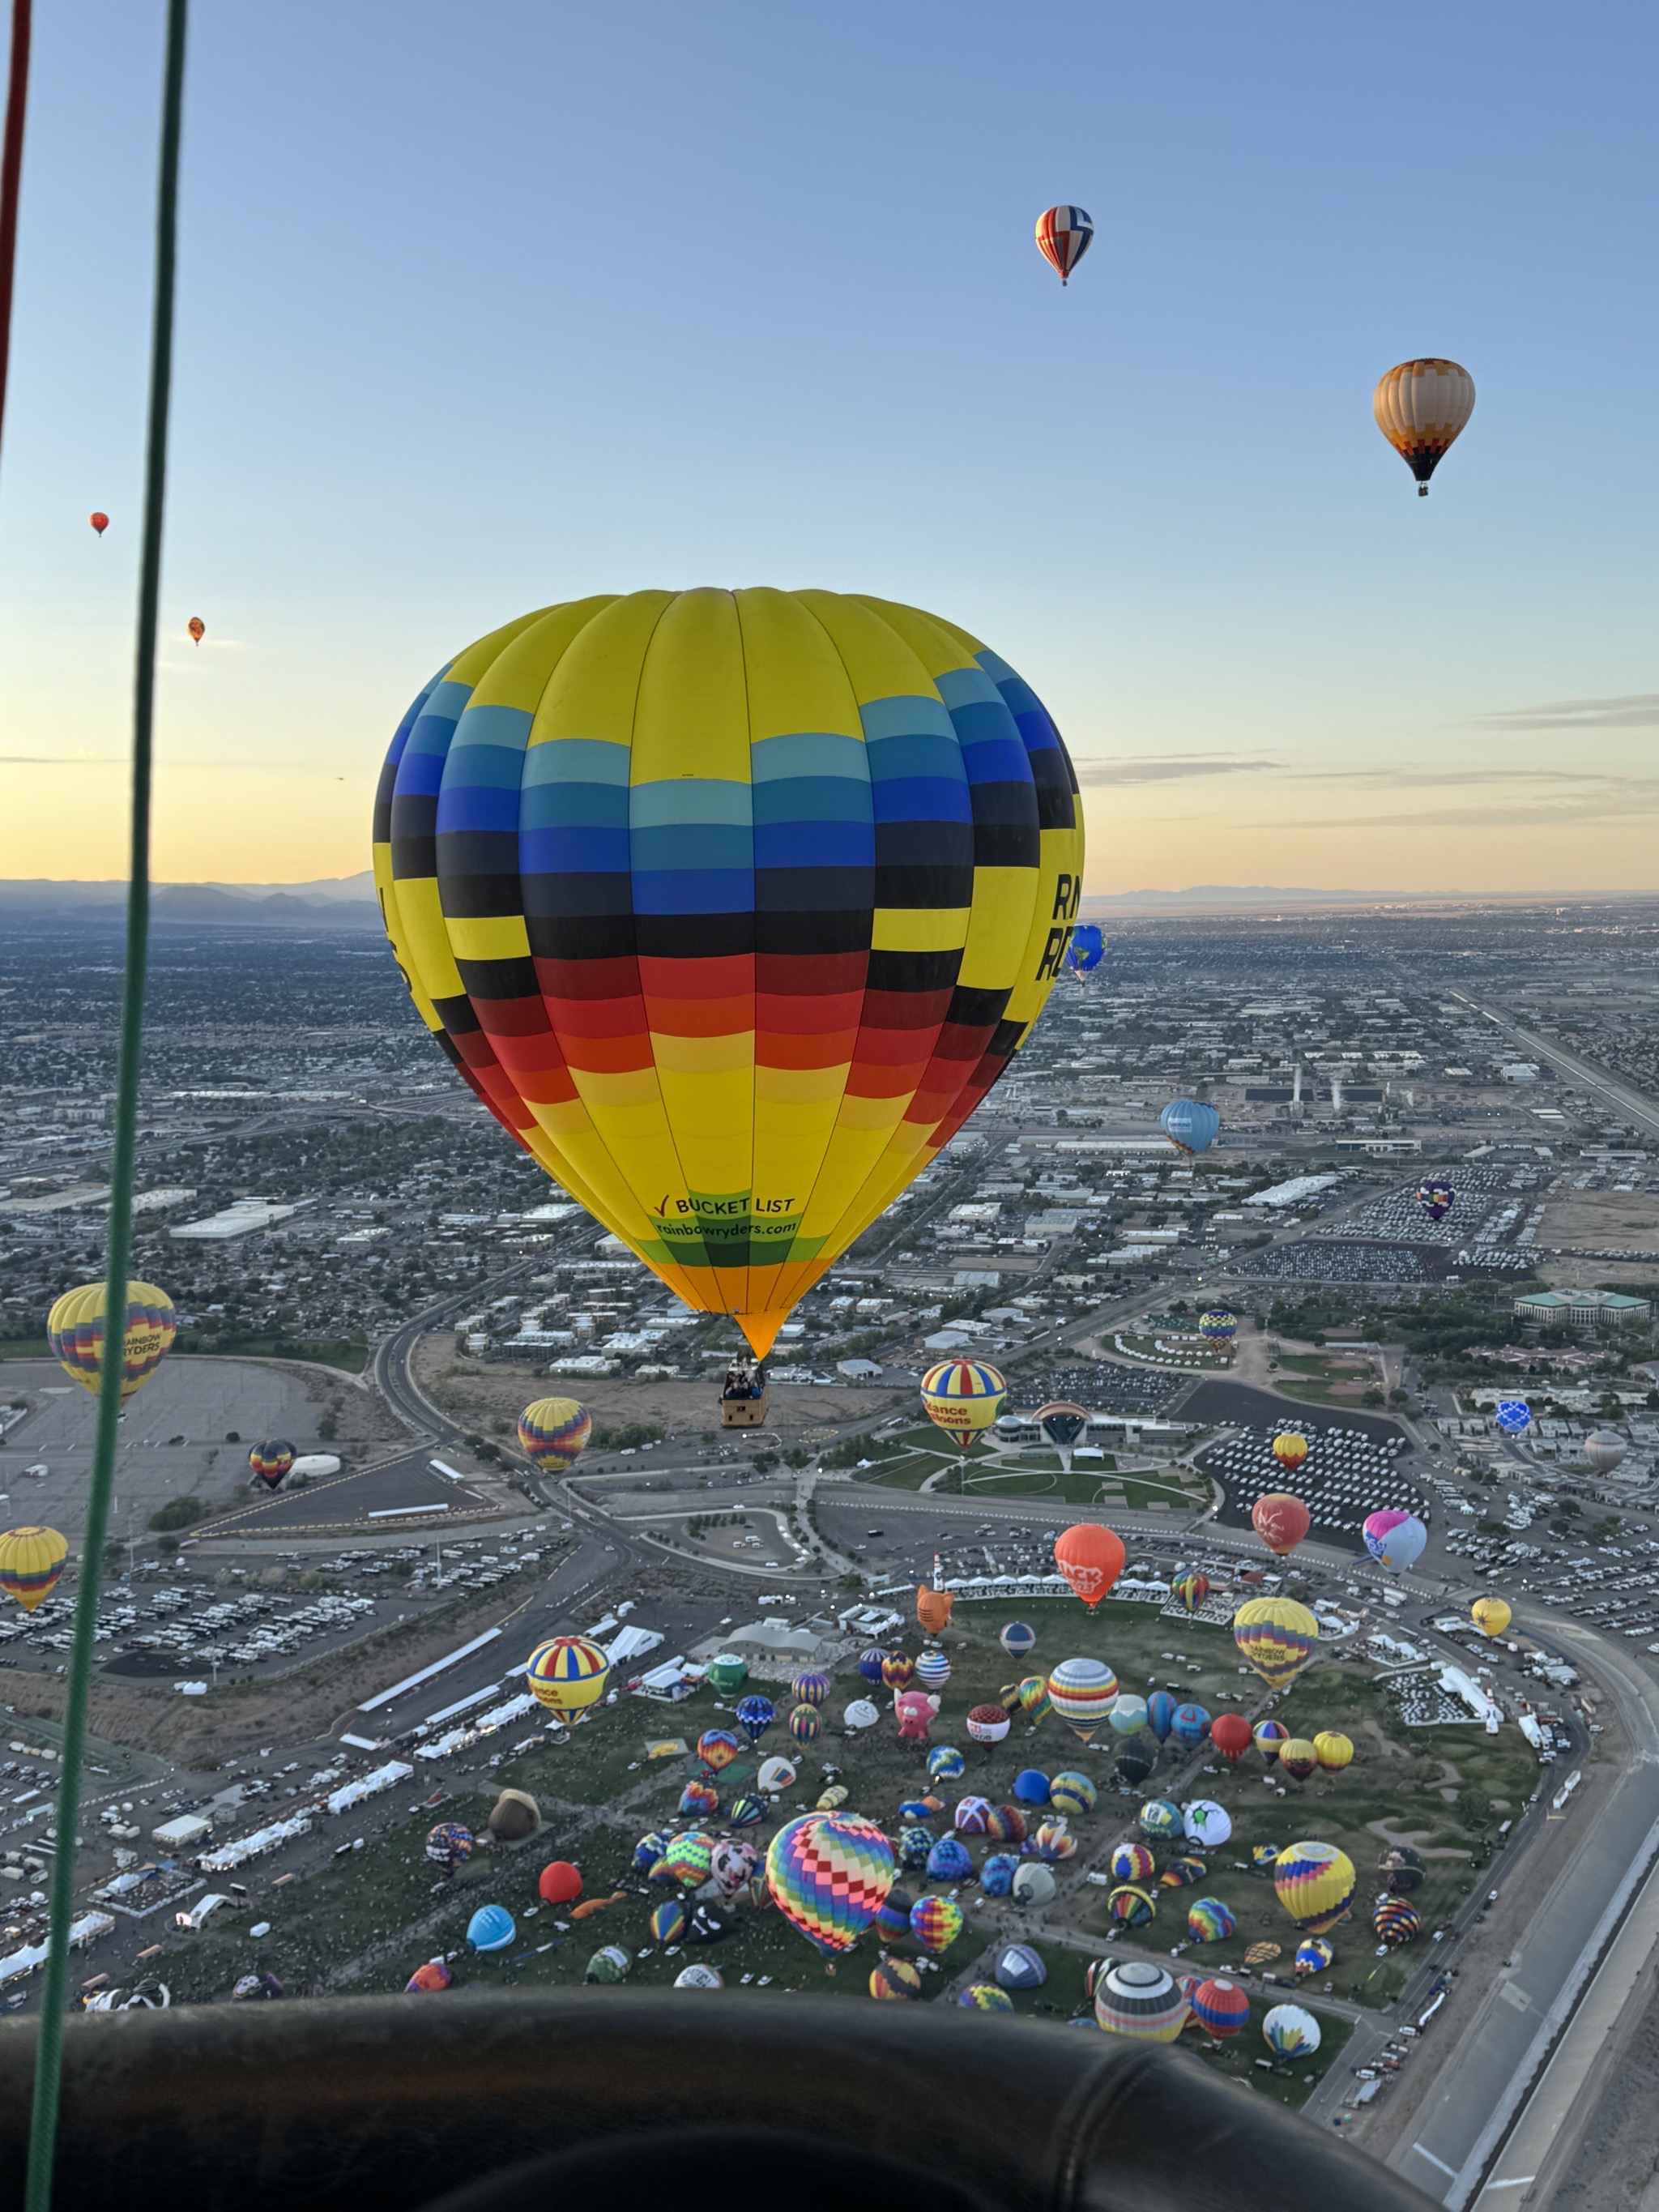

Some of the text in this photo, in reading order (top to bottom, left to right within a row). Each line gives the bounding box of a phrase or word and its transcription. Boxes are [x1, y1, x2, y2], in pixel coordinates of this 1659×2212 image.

[676, 1197, 795, 1215] BUCKET LIST
[656, 1222, 796, 1241] rainbowryders.com
[123, 1333, 161, 1347] AINBOW
